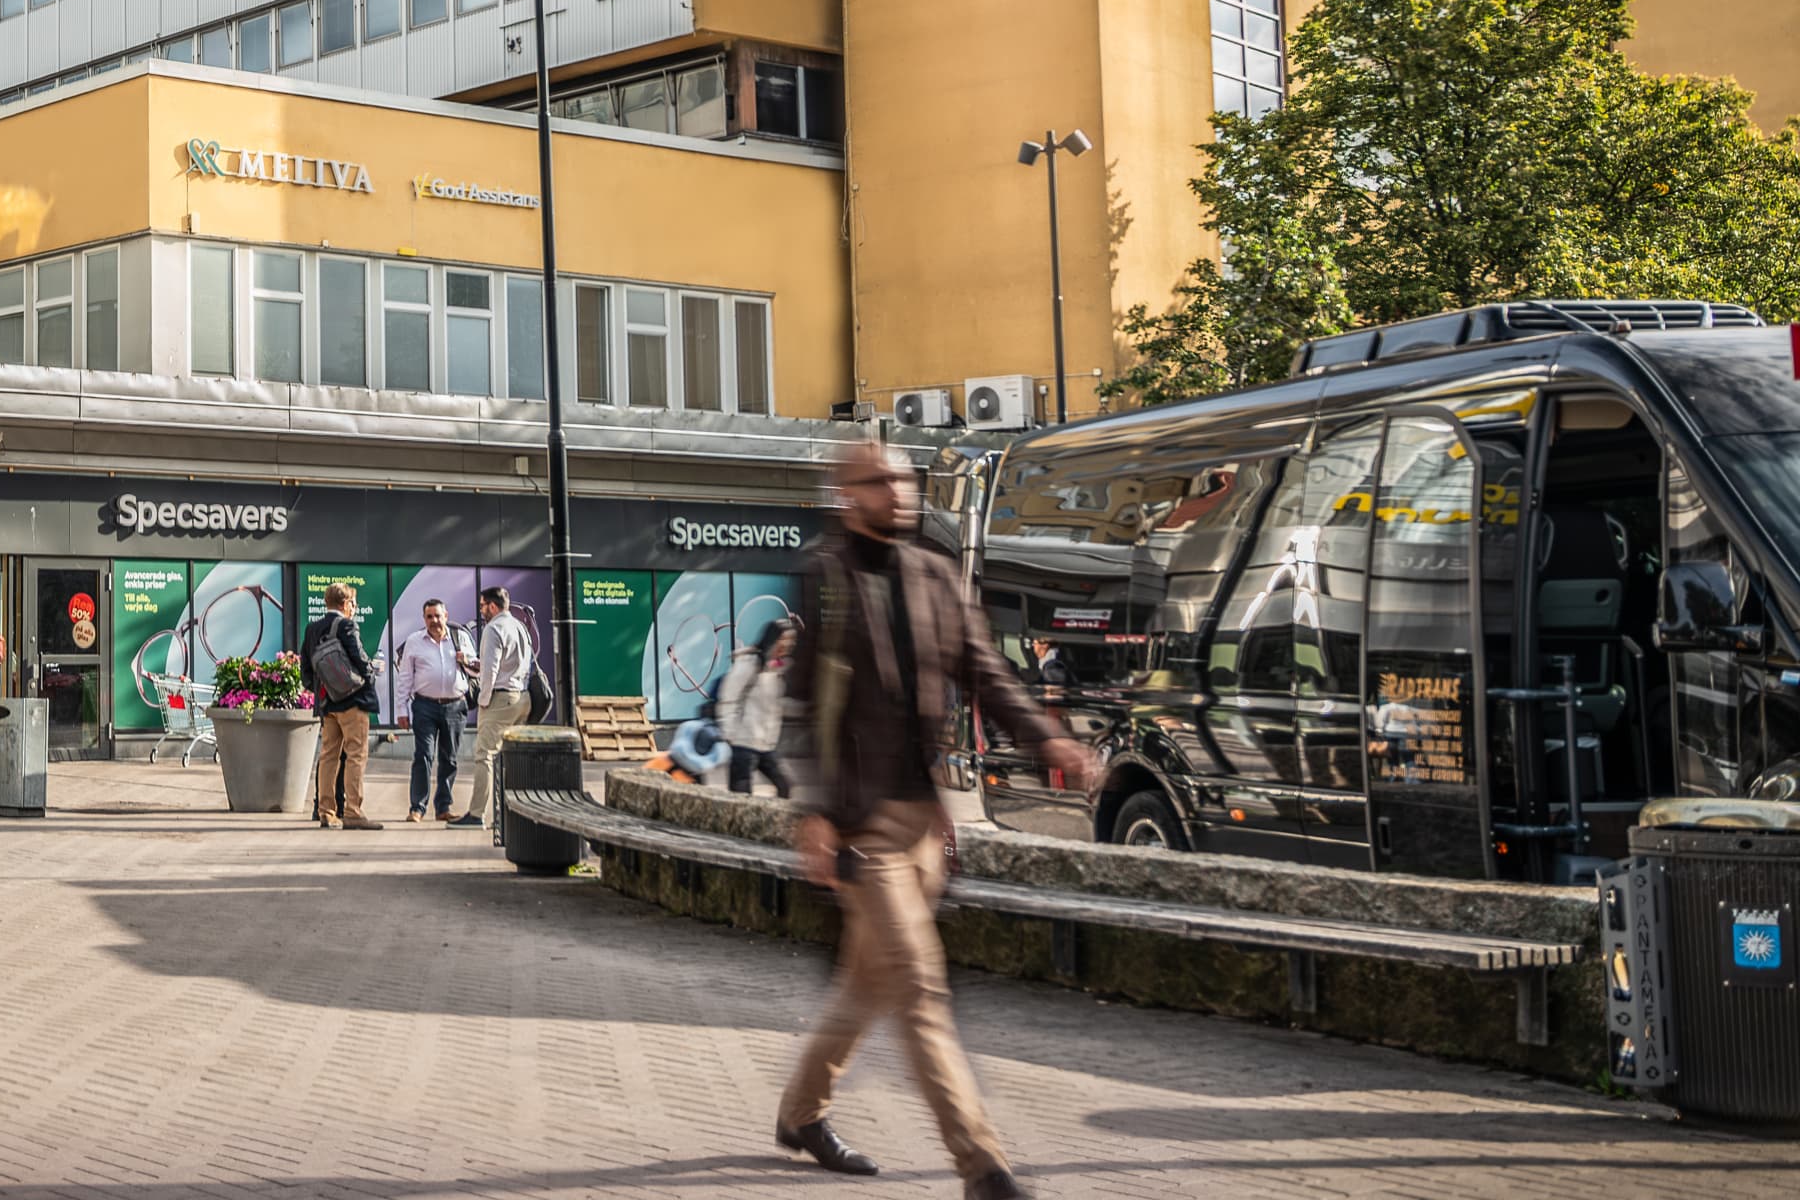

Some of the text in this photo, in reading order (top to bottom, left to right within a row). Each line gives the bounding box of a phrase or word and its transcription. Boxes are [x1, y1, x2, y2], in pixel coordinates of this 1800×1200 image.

[238, 149, 376, 193] MELIVA
[431, 178, 540, 209] God Assistans
[118, 494, 288, 533] Specsavers
[670, 517, 801, 550] Specsavers
[124, 570, 166, 581] Avancerade
[308, 574, 331, 583] Mindre
[124, 579, 167, 590] enkla priser
[583, 580, 596, 589] Glas
[124, 592, 135, 603] Till
[583, 596, 595, 605] och
[124, 602, 158, 614] varje dag
[360, 605, 373, 615] och
[71, 607, 91, 621] 50%
[1635, 894, 1658, 1061] PANTAMERA
